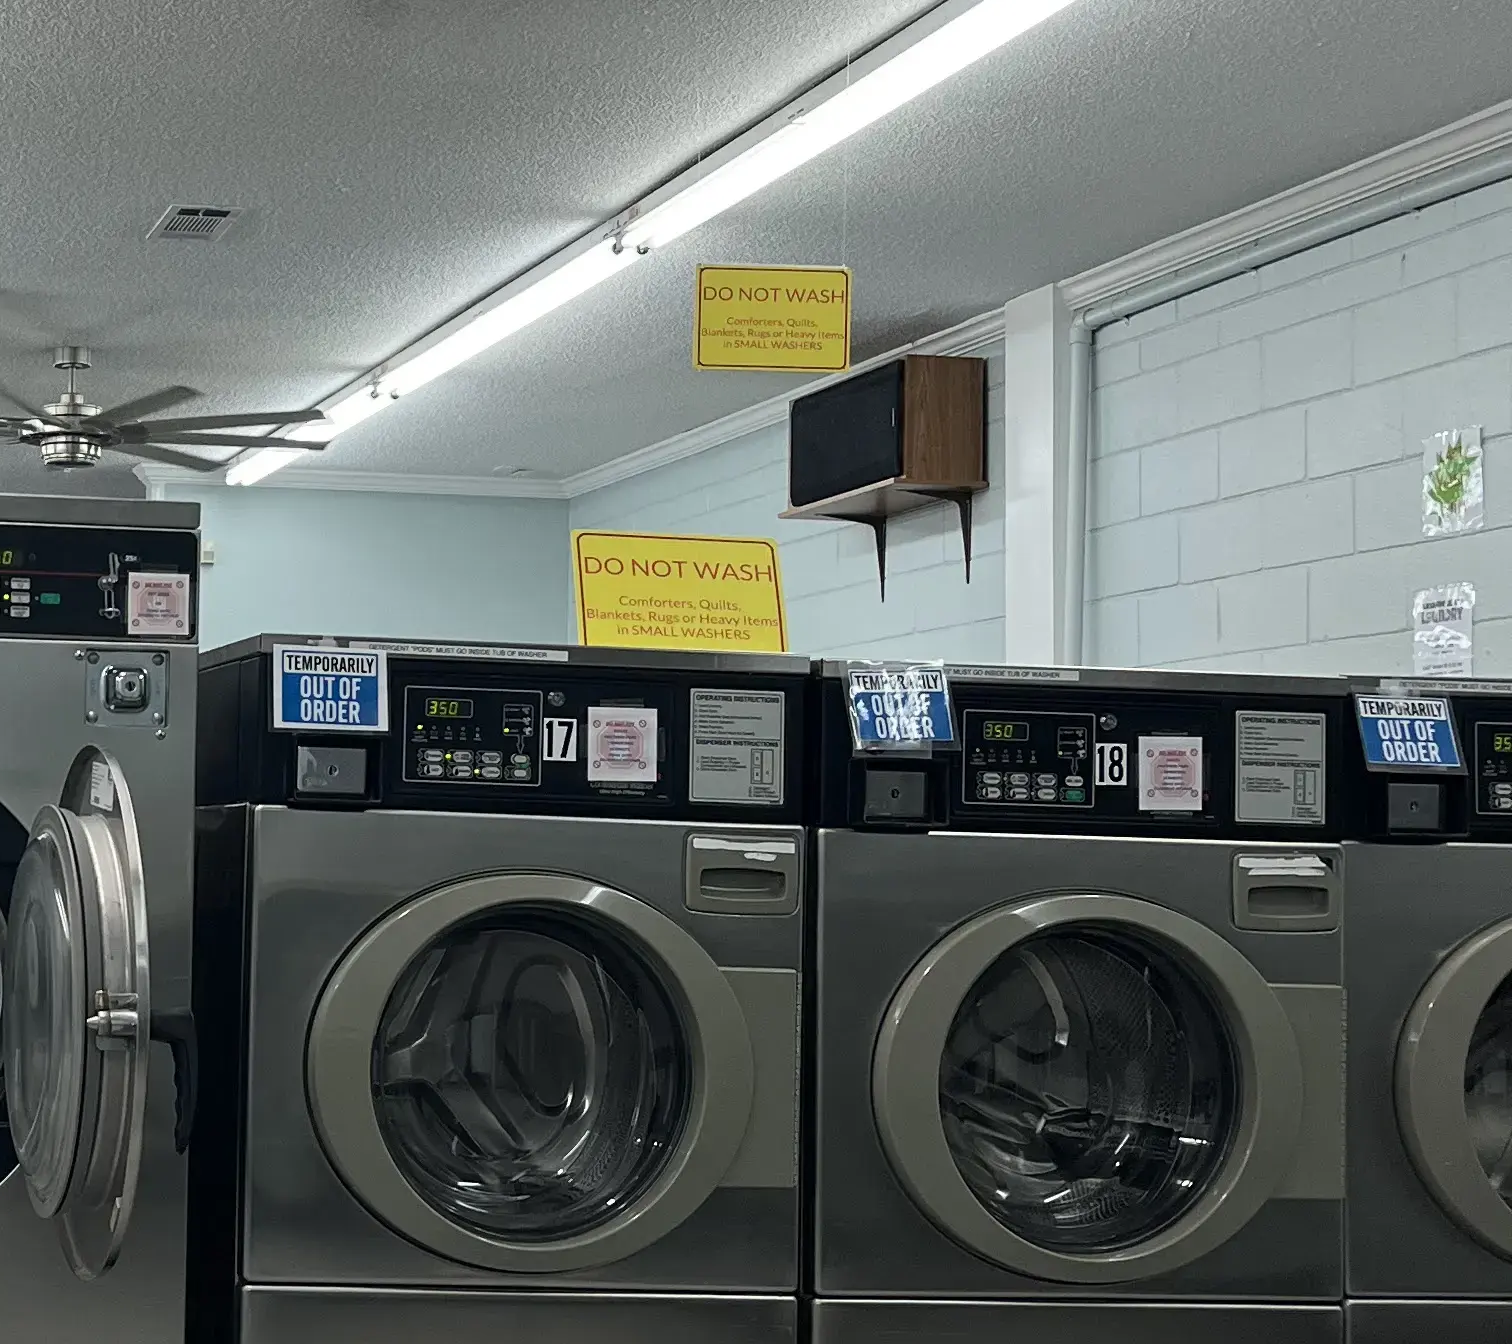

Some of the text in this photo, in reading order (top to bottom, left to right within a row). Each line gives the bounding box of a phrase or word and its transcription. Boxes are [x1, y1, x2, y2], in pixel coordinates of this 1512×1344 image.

[703, 286, 845, 304] DO NOT WASH
[747, 329, 772, 340] Rugs
[772, 330, 783, 338] or
[785, 329, 816, 340] Heavy
[818, 330, 845, 340] Items
[723, 340, 823, 351] in SMALL WASHERS
[584, 556, 773, 582] DO NOT WASH
[619, 596, 741, 613] Comforters, Quilts,
[587, 608, 778, 627] Blankets, Rugs or Heavy Items
[617, 625, 751, 641] in SMALL WASHERS
[435, 647, 455, 655] MUST
[468, 648, 490, 656] INSIDE
[492, 649, 506, 657] TUB
[518, 650, 548, 658] WASHER
[286, 654, 375, 674] TEMPORARILY
[953, 668, 973, 676] MUST
[974, 669, 984, 677] GO
[985, 669, 1006, 678] INSIDE
[1007, 670, 1021, 678] TUB
[1031, 671, 1061, 679] WASHER
[300, 675, 362, 700] OUT OF
[300, 699, 361, 724] ORDER
[429, 700, 459, 715] 350
[871, 692, 903, 716] OUT
[1361, 701, 1443, 718] TEMPORARILY
[875, 715, 935, 739] ORDER
[986, 724, 1014, 738] 350
[1377, 719, 1437, 741] OUT OF
[545, 720, 575, 758] 17
[1381, 741, 1442, 762] ORDER
[1097, 745, 1124, 783] 18
